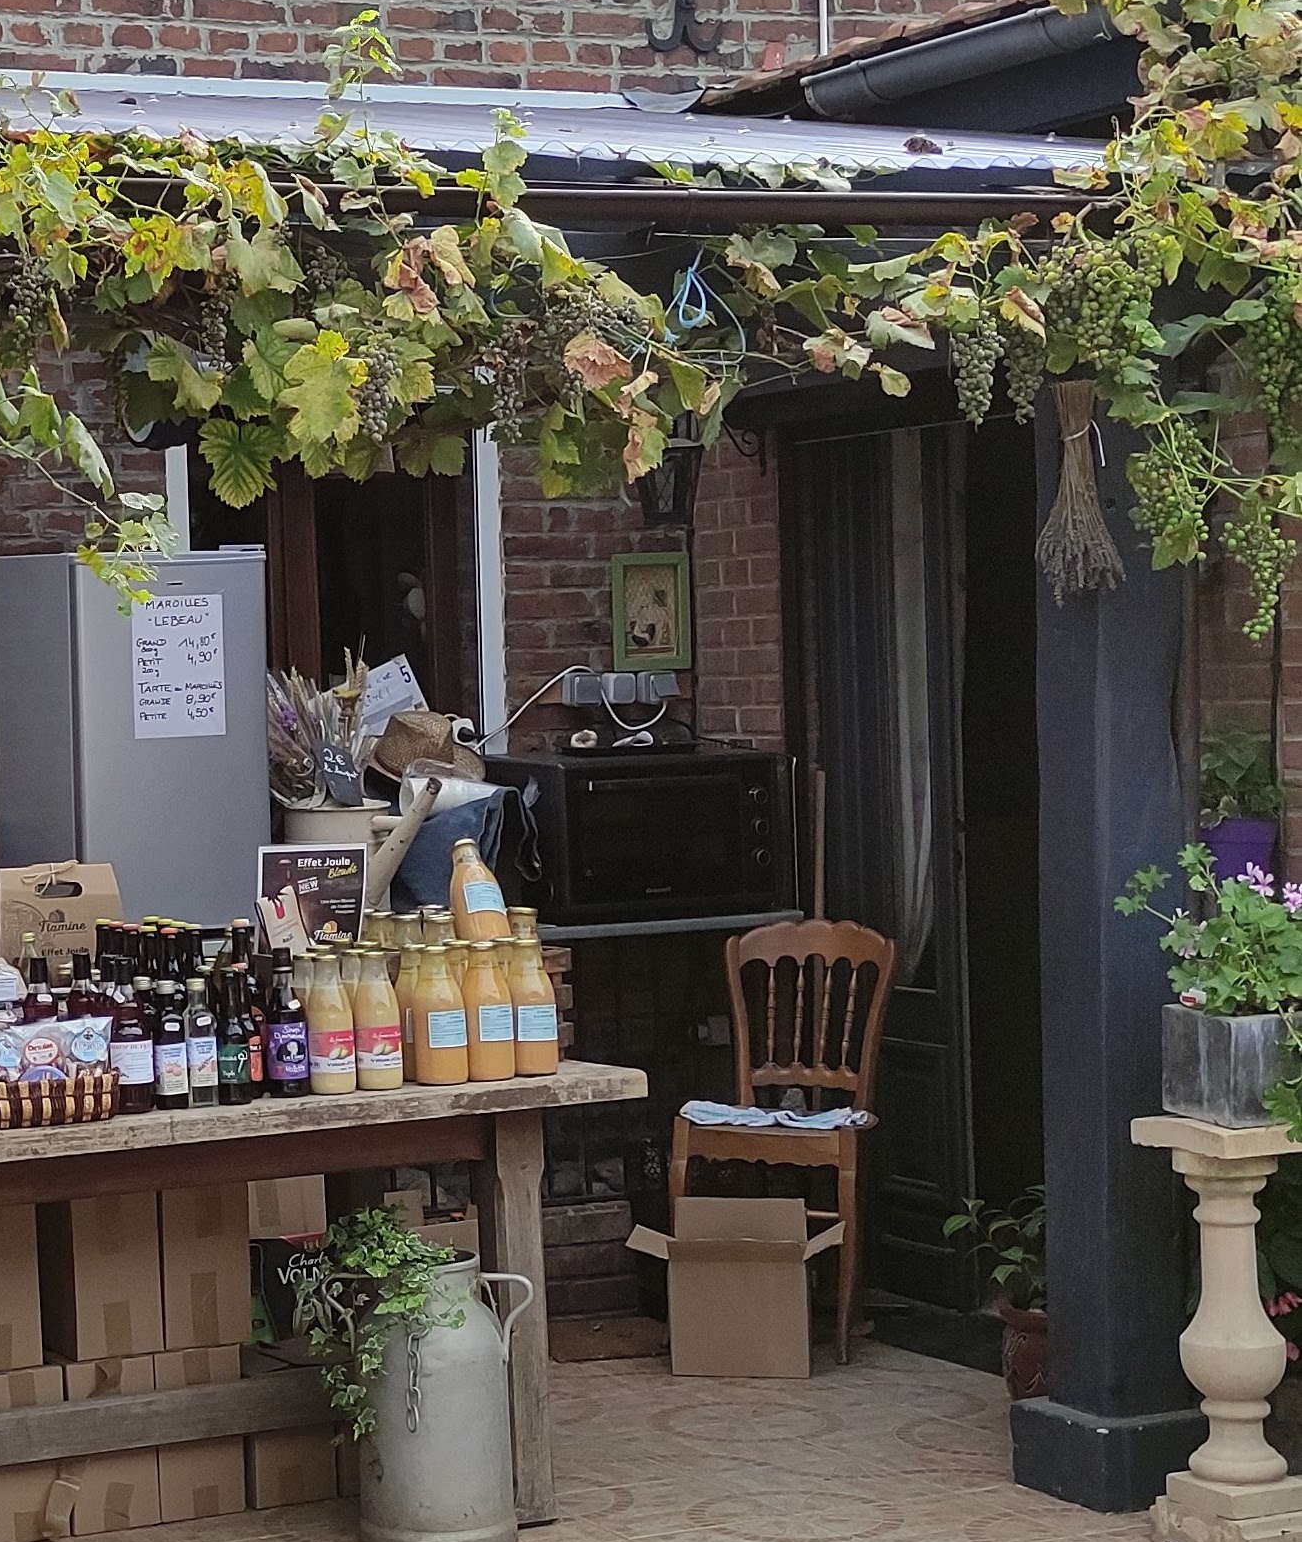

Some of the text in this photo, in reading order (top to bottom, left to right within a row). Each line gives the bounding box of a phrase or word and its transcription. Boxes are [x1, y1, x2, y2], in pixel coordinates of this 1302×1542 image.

[145, 597, 209, 611] MAROILLES
[136, 637, 167, 648] GRAND
[187, 648, 218, 666] 4,90€
[137, 681, 173, 694] TARTE
[185, 692, 216, 706] 8,90€
[187, 706, 214, 720] 4,50€
[323, 748, 346, 765] 2€
[298, 856, 351, 868] Effet Joule
[328, 862, 357, 879] Blonde
[298, 879, 319, 892] NEW
[42, 948, 64, 957] Effet
[288, 1251, 325, 1267] Charl
[277, 1266, 324, 1285] VOLN
